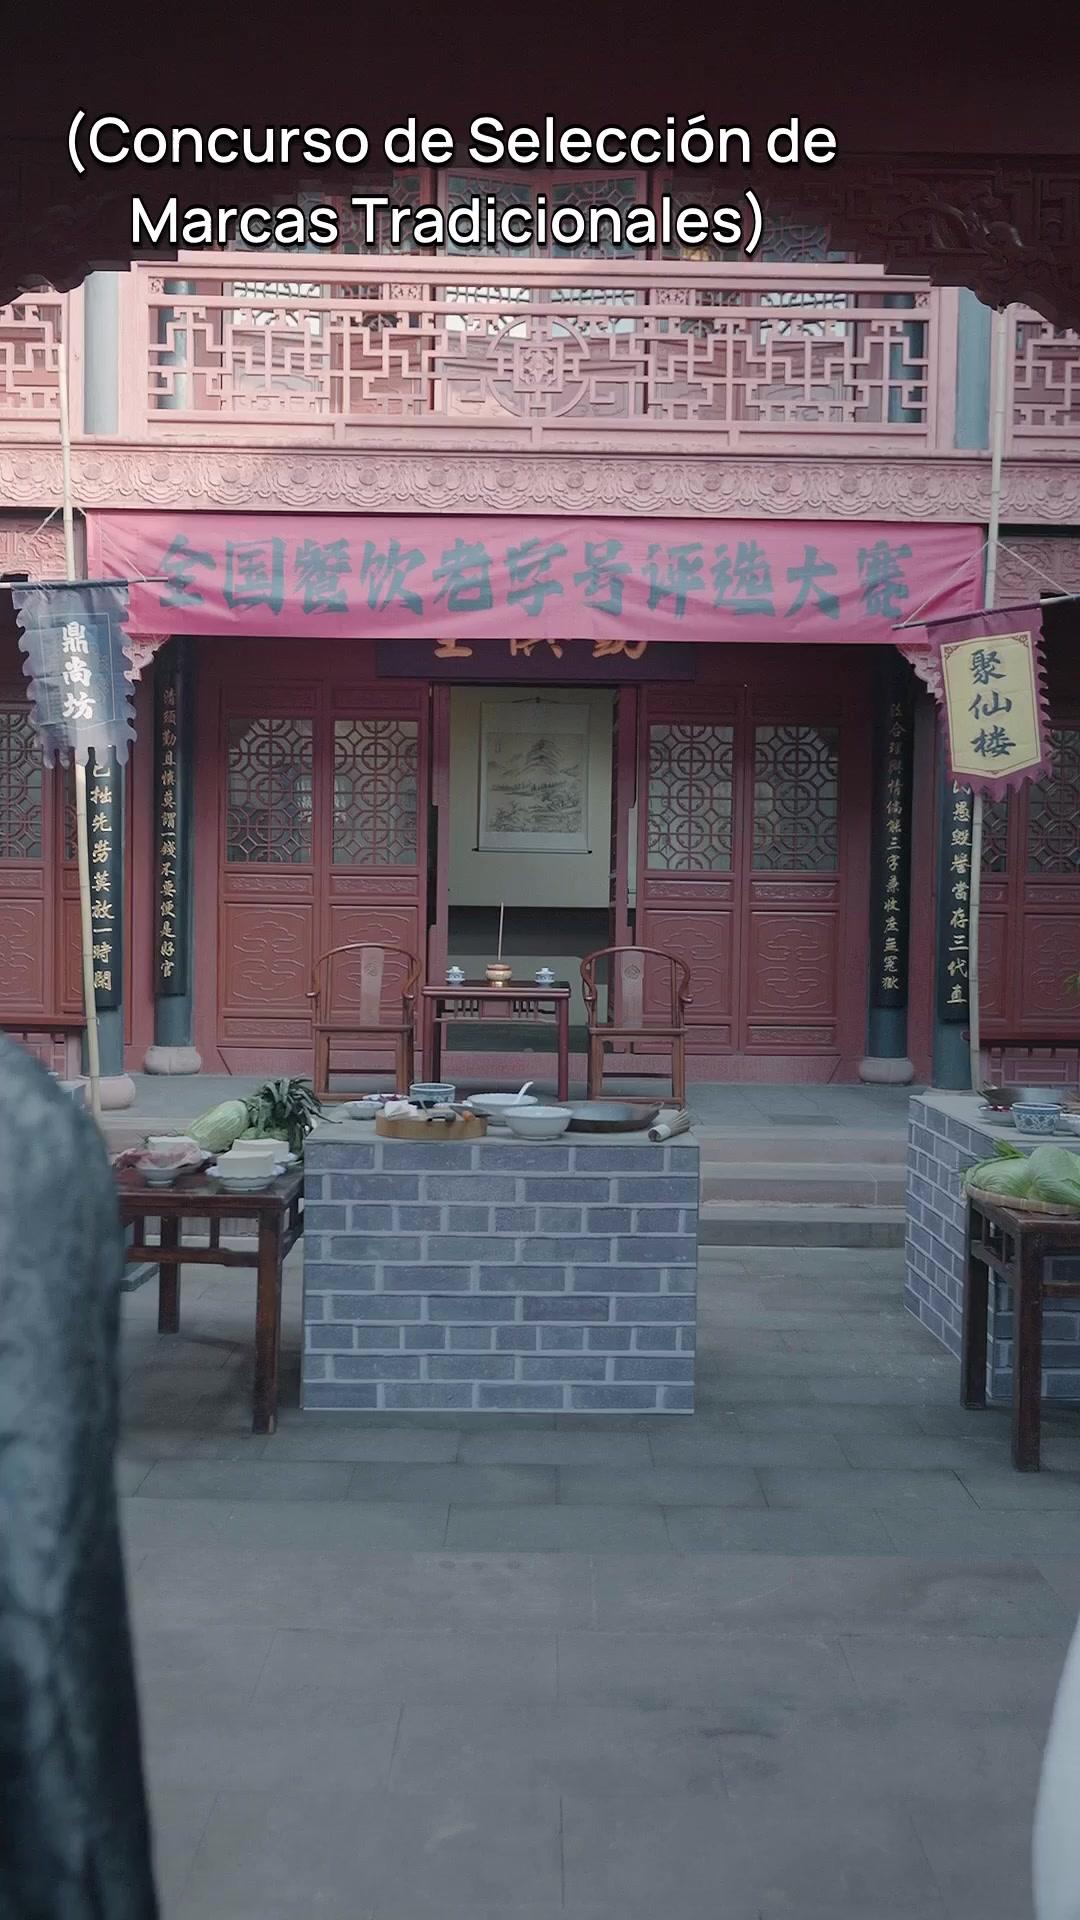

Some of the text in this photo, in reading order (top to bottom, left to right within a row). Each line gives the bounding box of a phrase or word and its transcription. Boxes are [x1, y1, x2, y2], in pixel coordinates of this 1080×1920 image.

[160, 534, 913, 619] 全国餐饮老字号评选大赛
[62, 620, 96, 720] 鼎尚坊
[968, 648, 1017, 758] 聚仙楼
